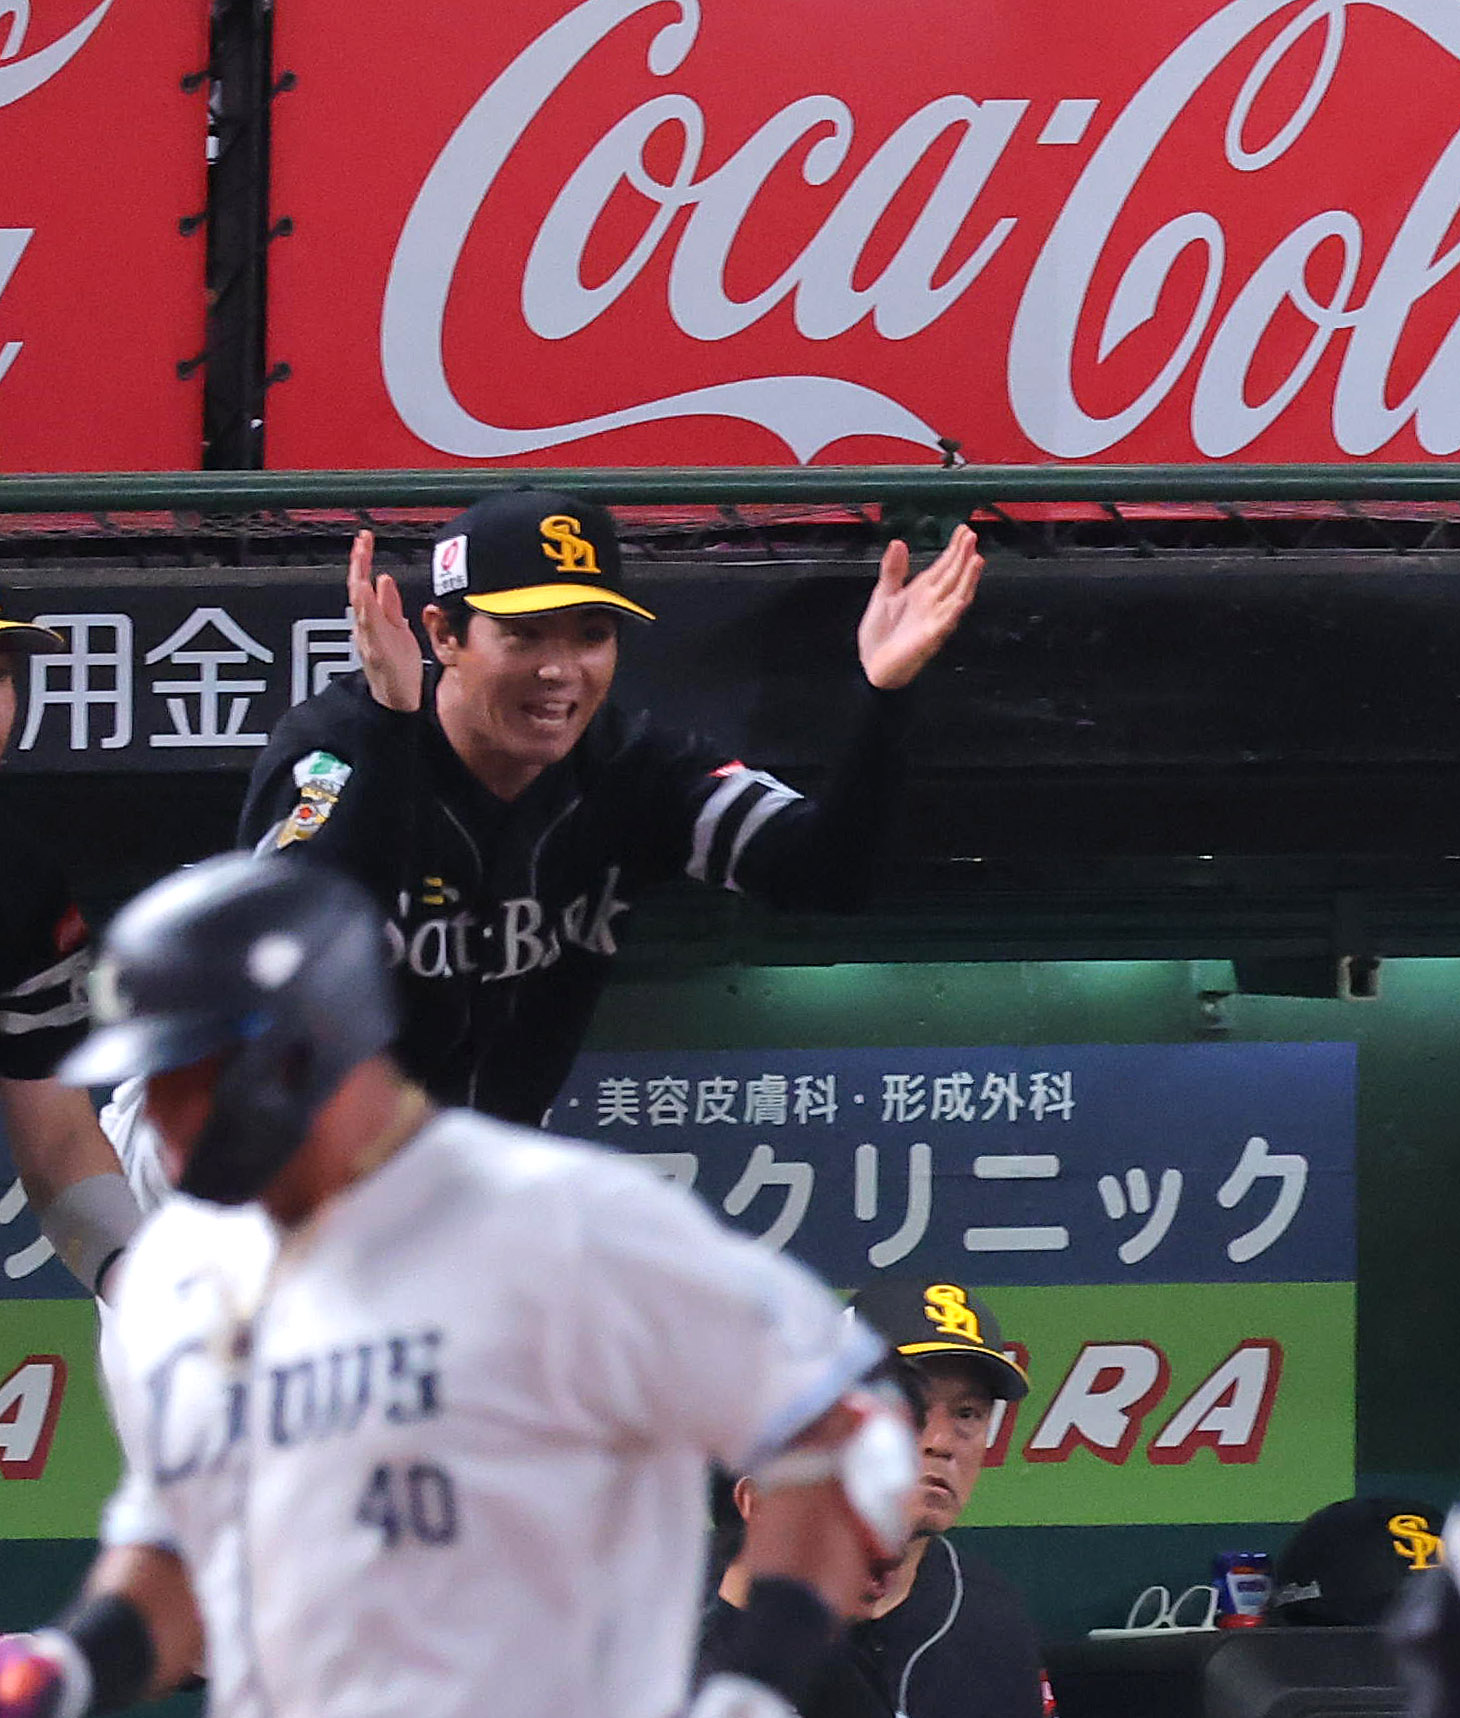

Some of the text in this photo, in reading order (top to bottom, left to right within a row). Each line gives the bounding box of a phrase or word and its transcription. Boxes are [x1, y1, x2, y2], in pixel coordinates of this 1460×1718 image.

[540, 1071, 1076, 1128] ・美容皮膚科・形成外科
[355, 1459, 458, 1551] 40
